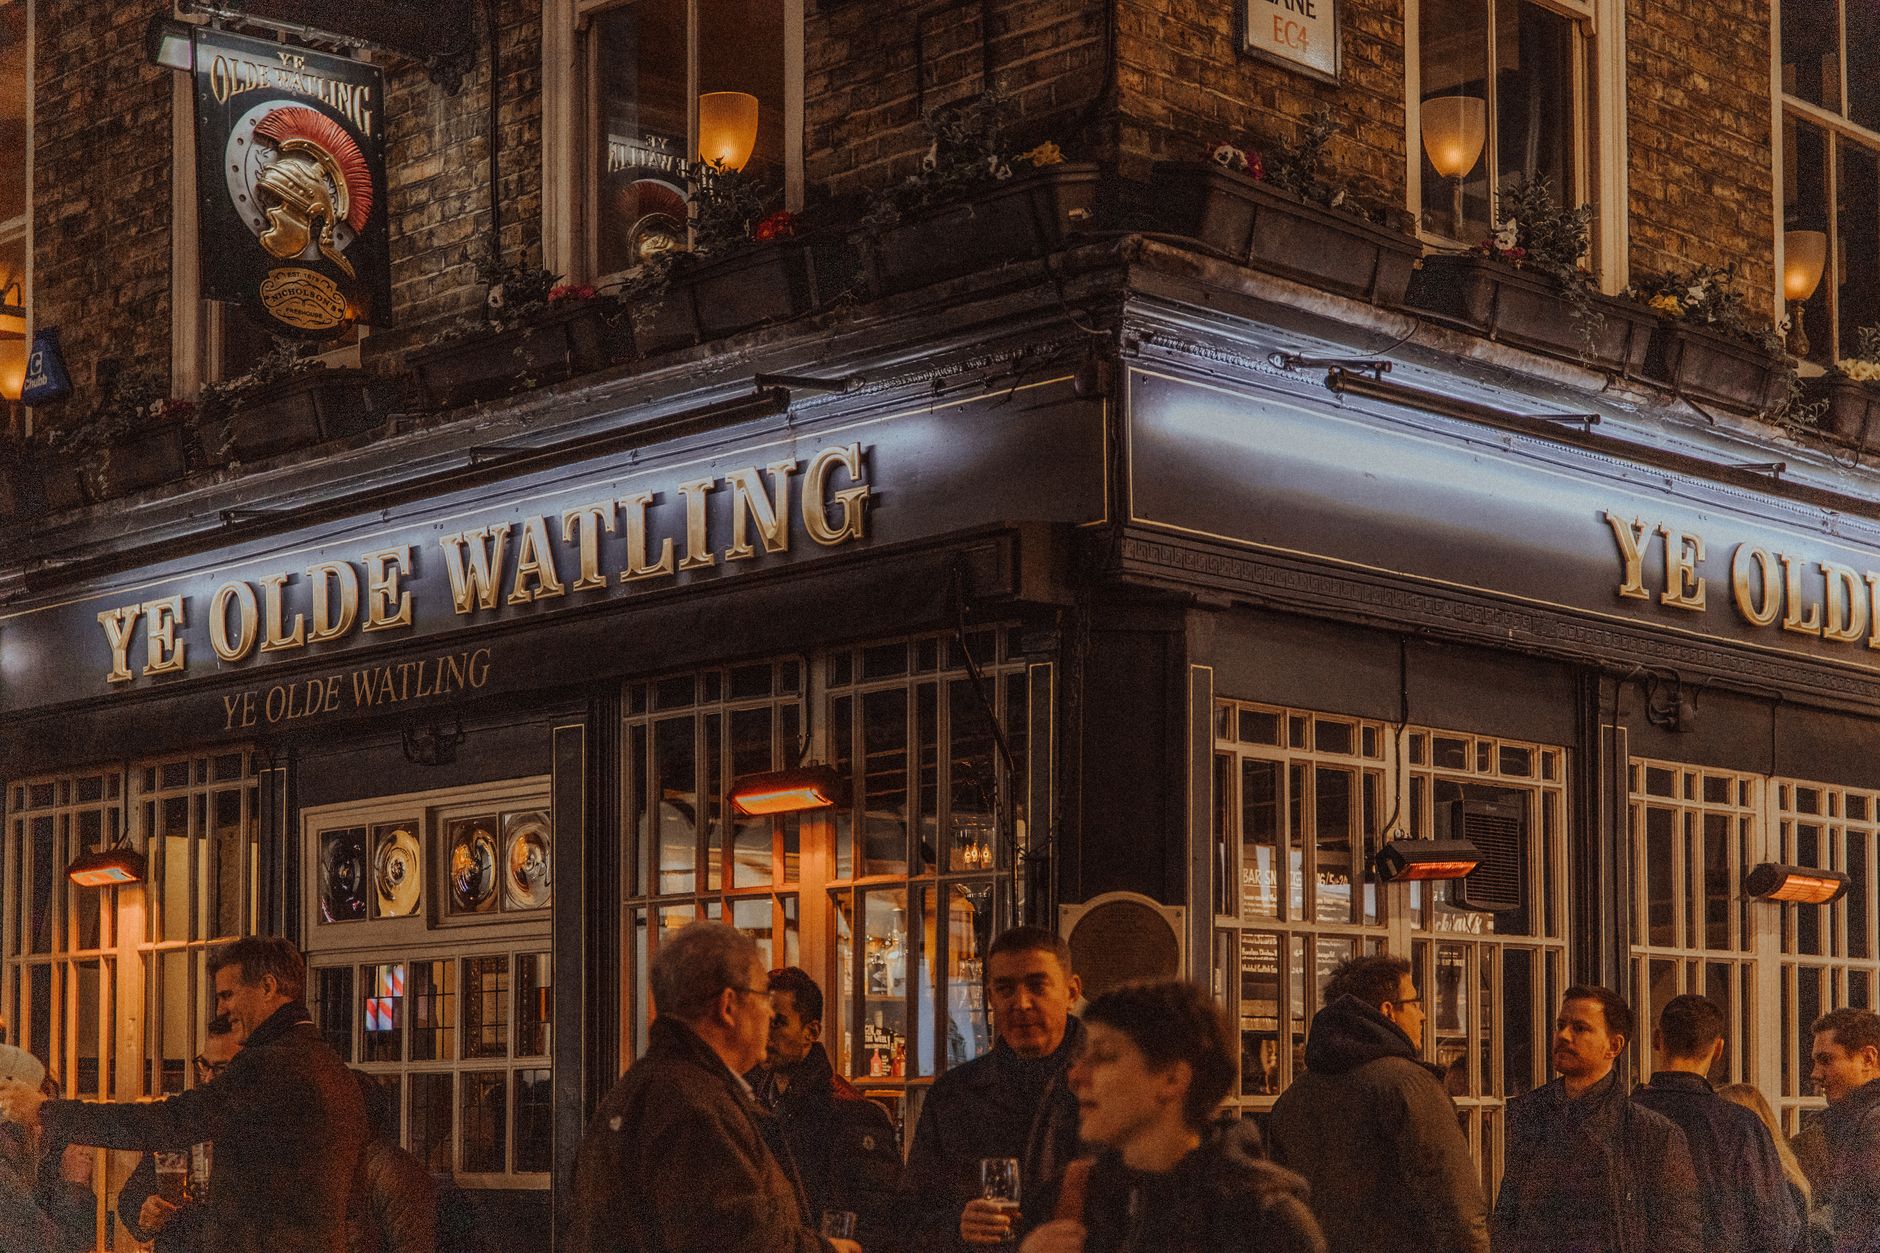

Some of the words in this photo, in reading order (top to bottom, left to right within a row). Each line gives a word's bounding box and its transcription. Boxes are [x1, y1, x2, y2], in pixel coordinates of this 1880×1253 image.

[1265, 0, 1317, 19] NE
[1273, 14, 1310, 53] EC4
[277, 51, 305, 71] YE
[210, 55, 271, 105] OLDE
[273, 67, 373, 139] WATLING
[271, 288, 338, 312] NICHOLSON'S
[24, 373, 48, 391] Chubb
[97, 594, 186, 683] YE
[208, 543, 413, 662] OLDE
[439, 441, 871, 615] WATLING
[1604, 508, 1707, 612] YE
[223, 690, 259, 730] YE
[265, 674, 344, 723] OLDE
[352, 647, 492, 708] WATLING
[1242, 867, 1261, 885] BAR
